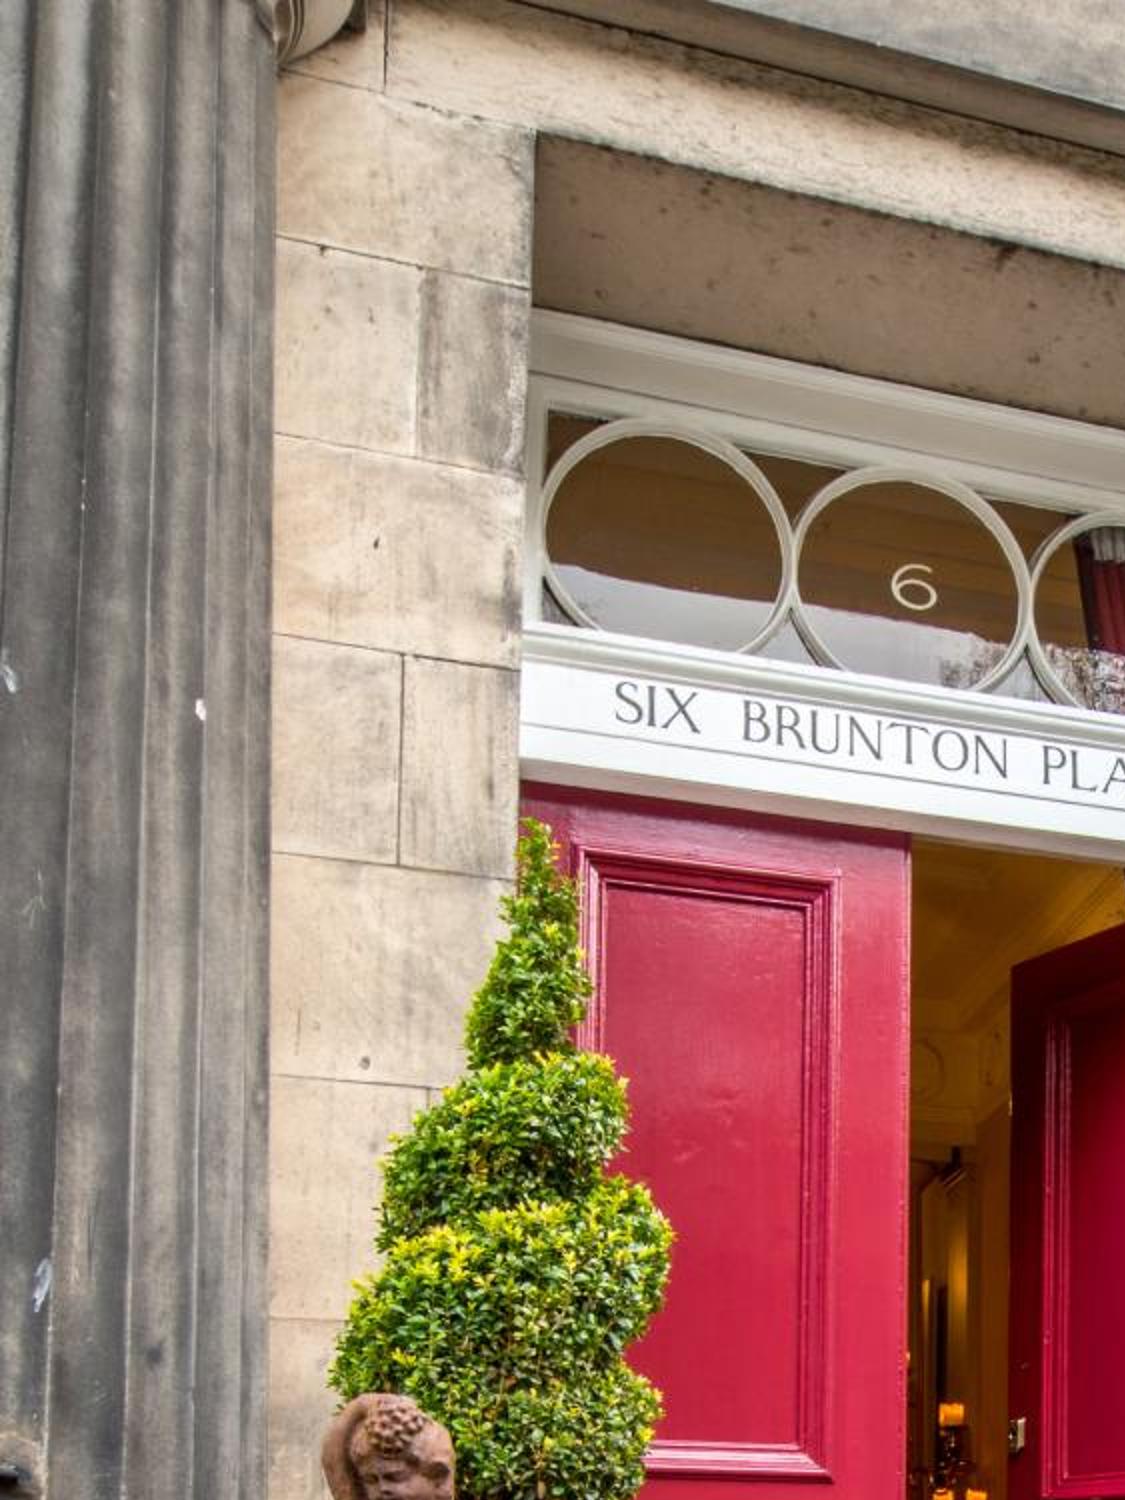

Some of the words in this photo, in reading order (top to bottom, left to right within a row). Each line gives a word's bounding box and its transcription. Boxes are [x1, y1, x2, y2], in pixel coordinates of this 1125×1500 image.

[891, 562, 937, 610] 6
[614, 681, 701, 734] SIX
[742, 699, 1008, 779] BRUNTON
